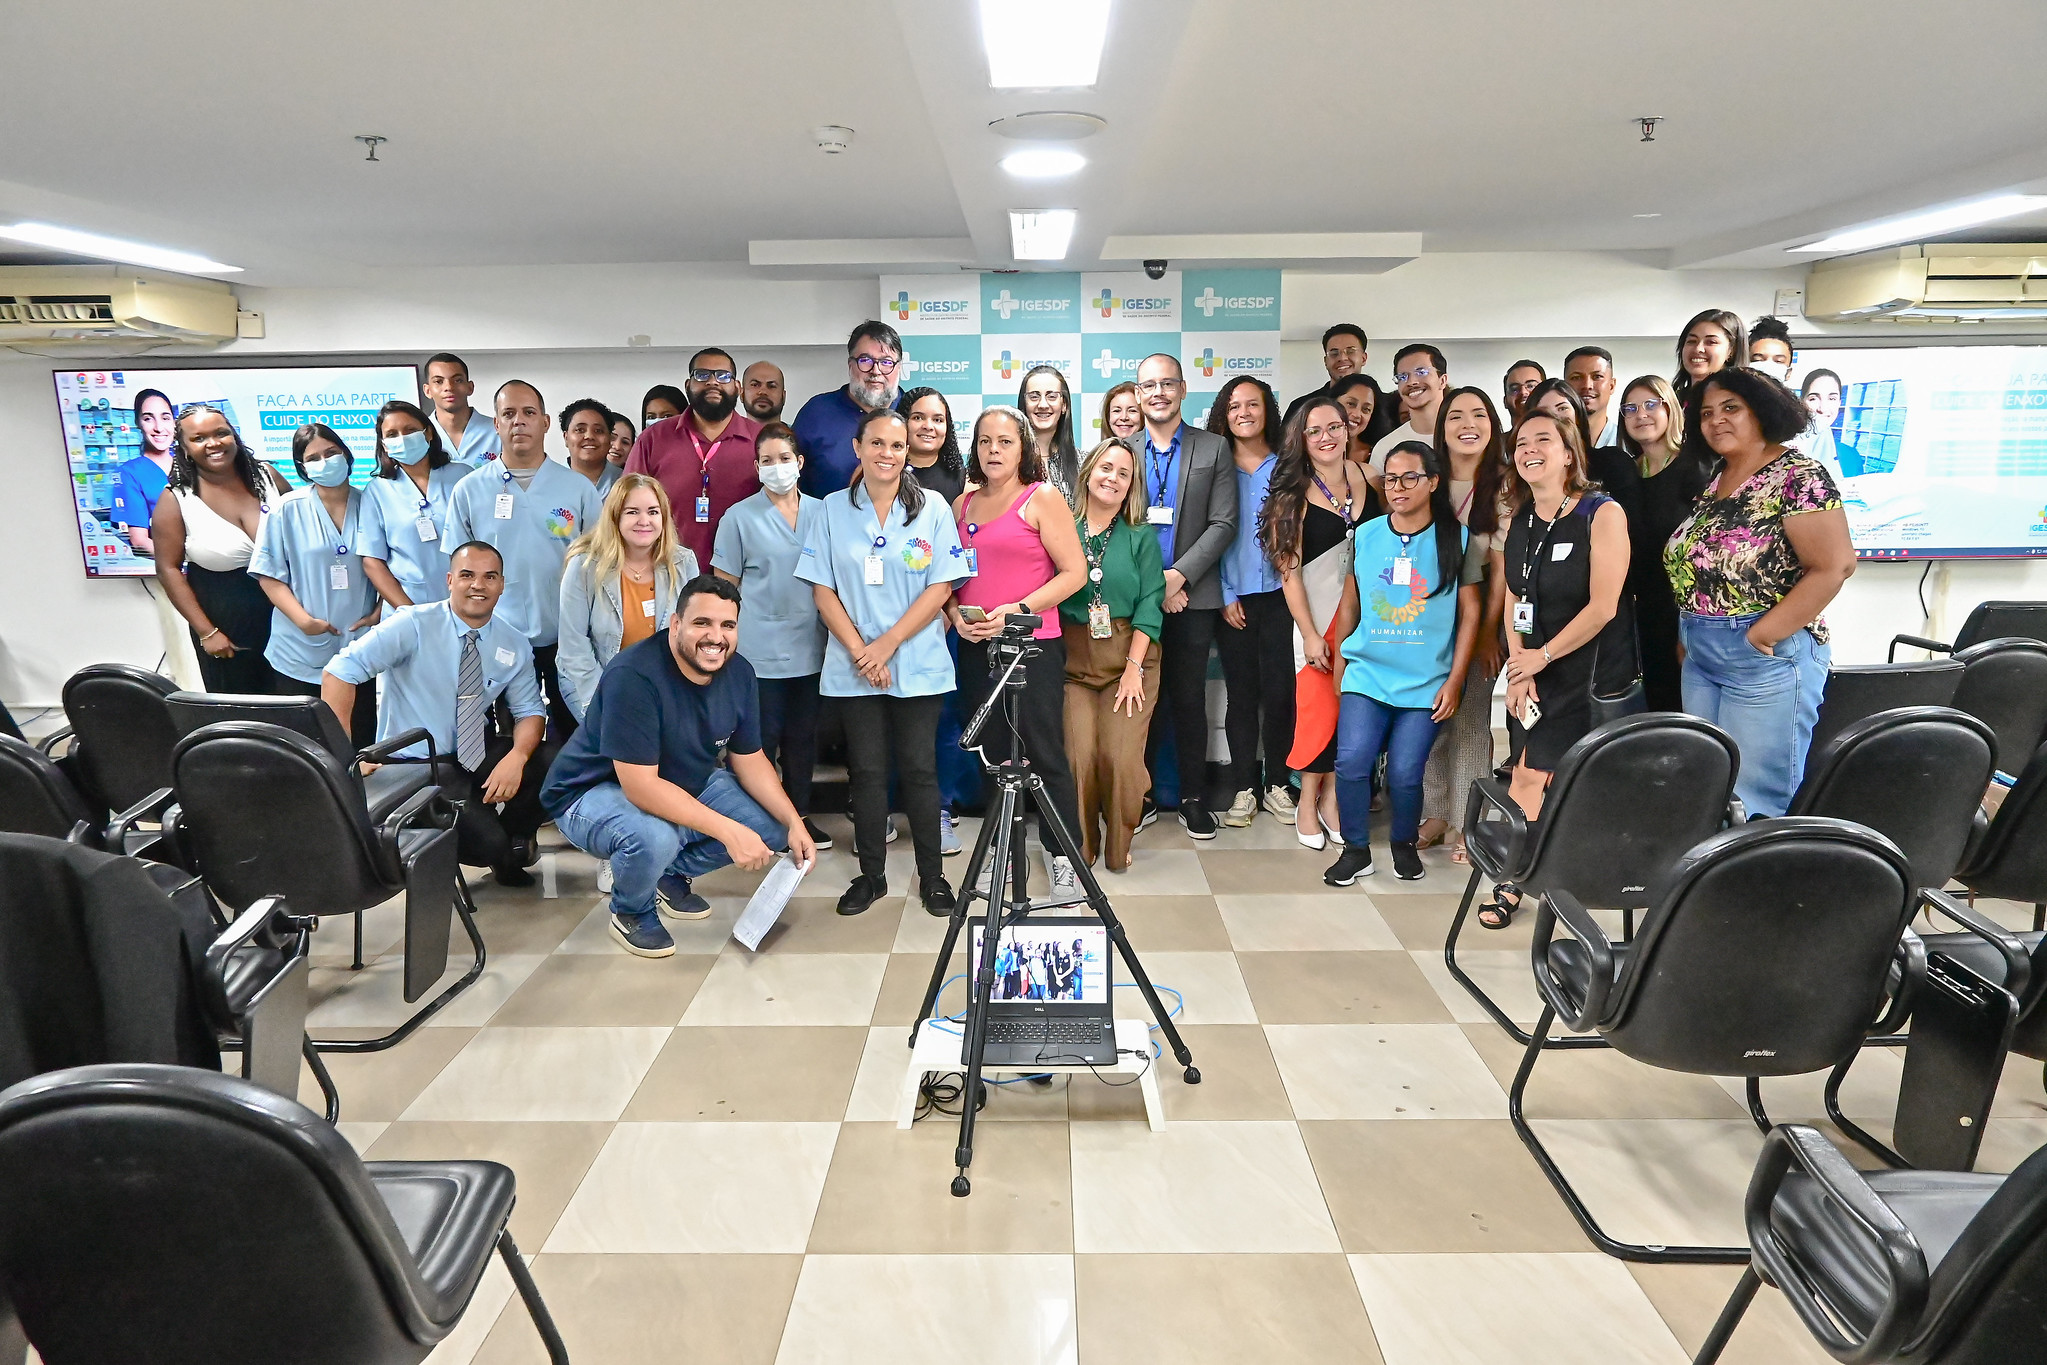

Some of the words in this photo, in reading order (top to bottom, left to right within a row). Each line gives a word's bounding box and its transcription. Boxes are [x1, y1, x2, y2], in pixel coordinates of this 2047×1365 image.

[920, 301, 968, 312] IGESDF
[1021, 300, 1070, 311] IGESDF
[1122, 298, 1171, 310] IGESDF
[1224, 297, 1274, 308] IGESDF
[921, 361, 969, 372] IGESDF
[1224, 358, 1273, 369] IGESDF
[256, 394, 297, 409] FAÇA
[302, 394, 313, 406] A
[316, 393, 347, 406] SUA
[2006, 394, 2047, 406] ENXO
[264, 415, 304, 427] CUIDE
[308, 414, 329, 426] DO
[334, 413, 377, 425] ENXOV
[2029, 524, 2047, 532] IGES
[1370, 628, 1423, 636] HUMANIZAR
[1743, 1049, 1776, 1057] giroflex
